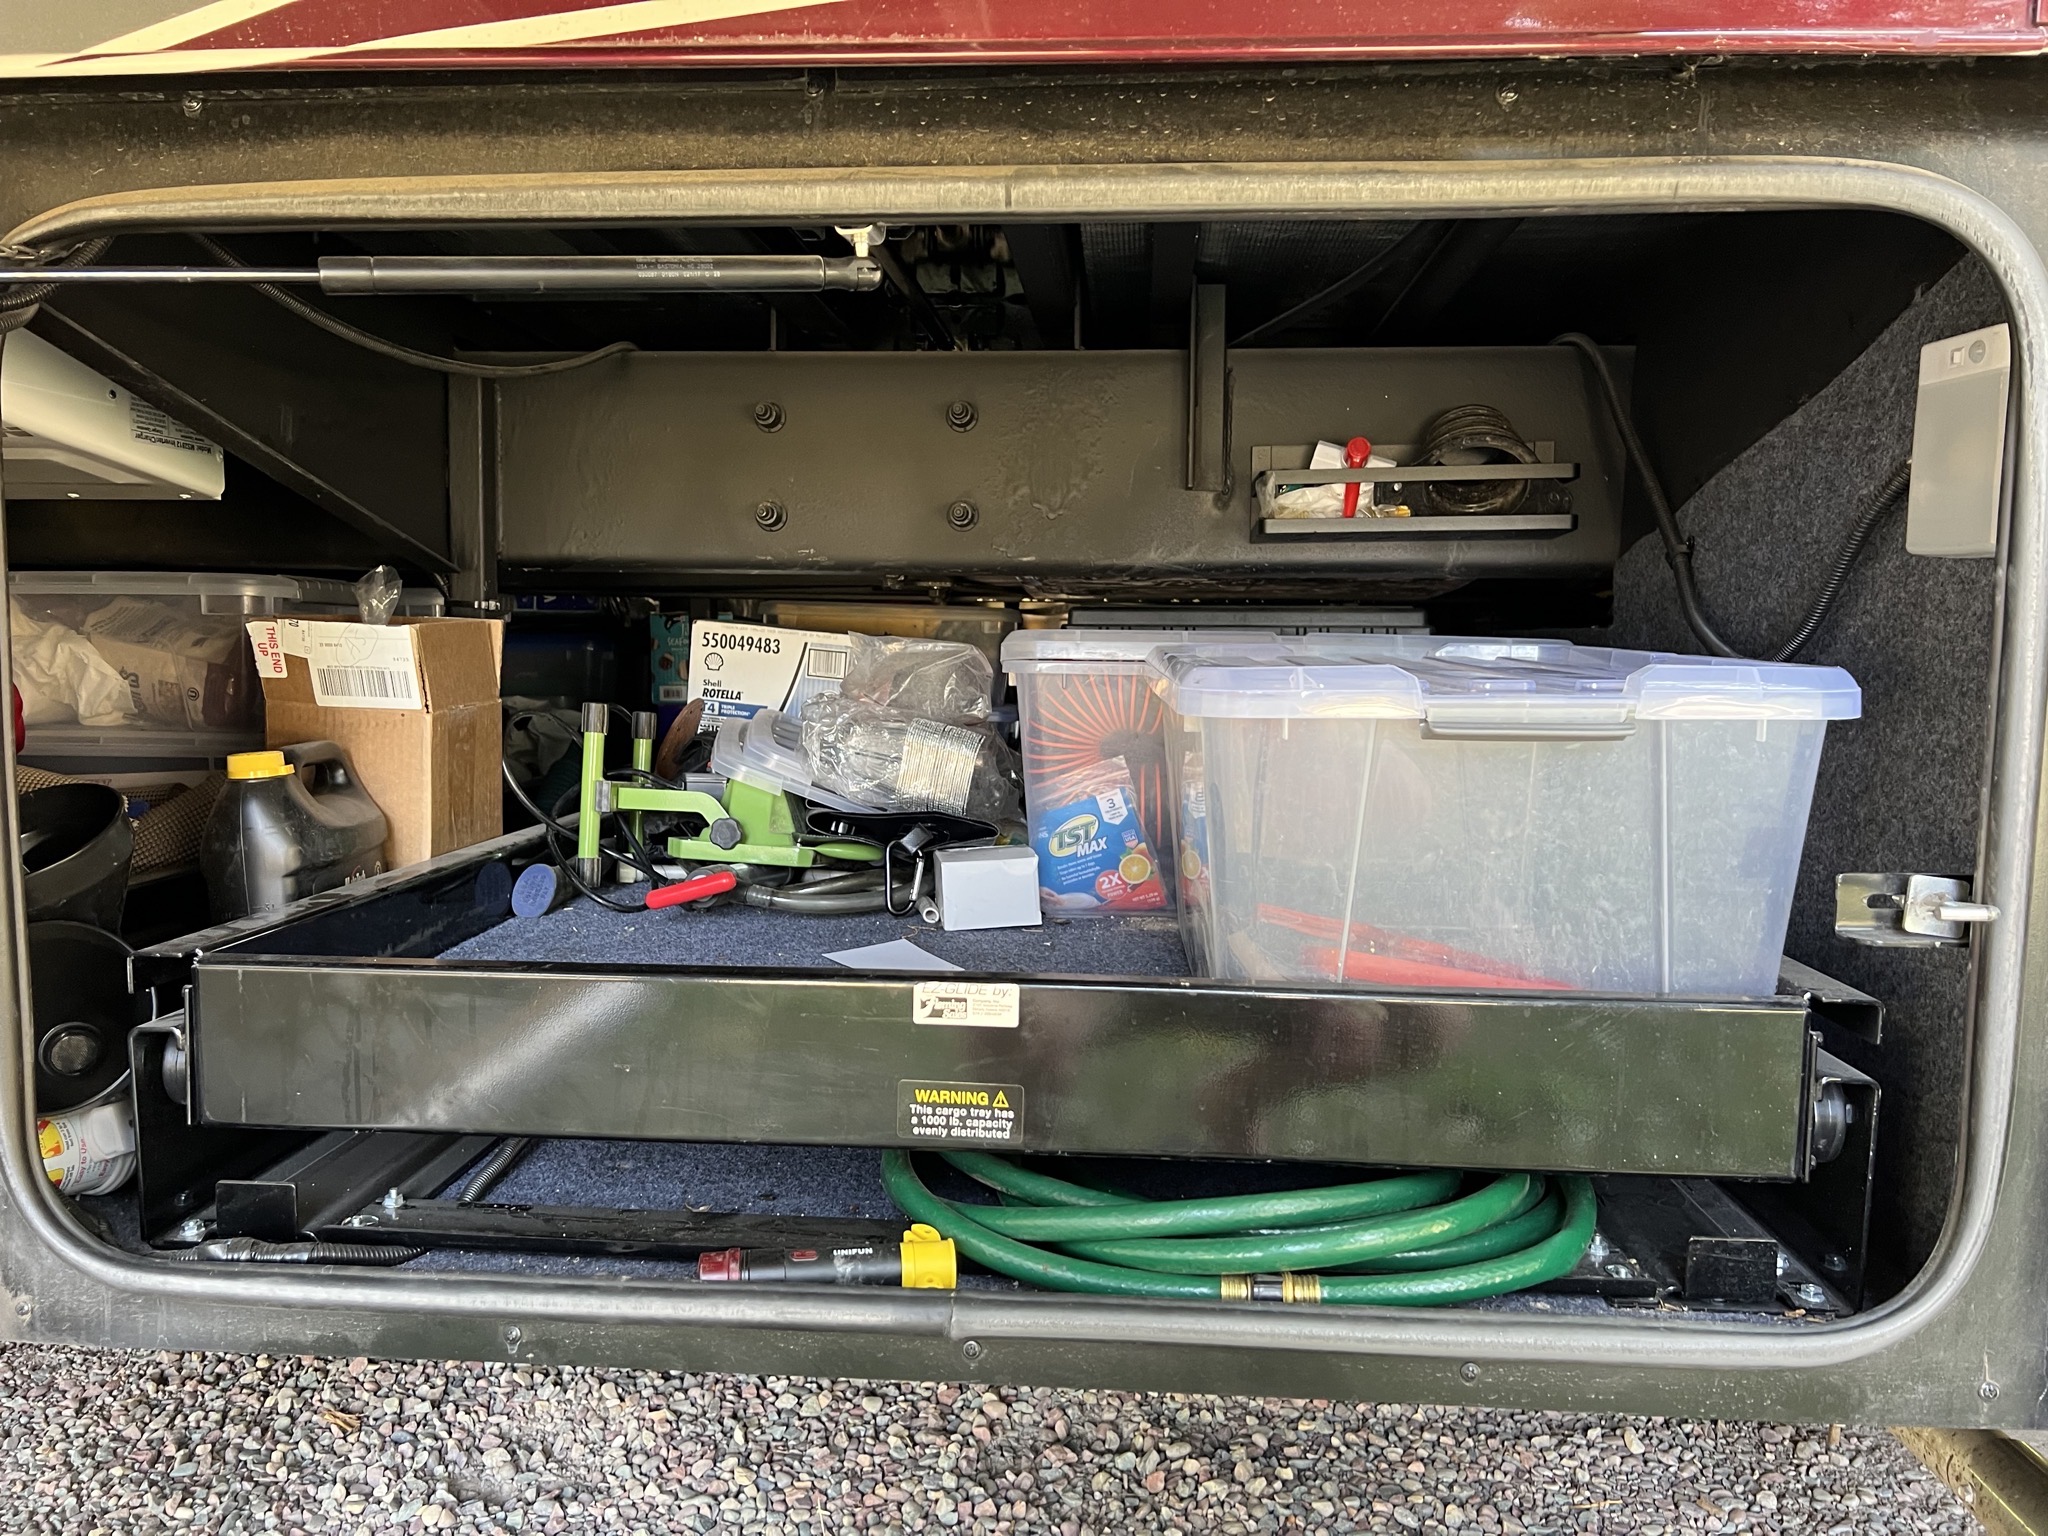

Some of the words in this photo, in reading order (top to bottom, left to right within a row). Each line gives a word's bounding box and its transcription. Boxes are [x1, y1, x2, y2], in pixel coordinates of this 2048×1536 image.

[265, 626, 279, 650] THIS
[701, 632, 781, 654] 550049483
[257, 642, 269, 657] UP
[271, 649, 283, 674] END
[702, 678, 722, 688] Shell
[702, 687, 742, 701] ROTELLA
[720, 703, 735, 711] TRIPLE
[1106, 798, 1116, 809] 3
[1052, 820, 1096, 851] TST
[1077, 836, 1108, 858] MAX
[1099, 872, 1123, 890] 2X
[922, 982, 987, 996] EZ-GLIDE
[993, 986, 1013, 998] by:
[914, 1088, 989, 1106] WARNING
[909, 1104, 933, 1115] This
[935, 1107, 967, 1118] cargo
[970, 1107, 992, 1119] tray
[994, 1108, 1015, 1119] has
[910, 1117, 918, 1125] a
[921, 1115, 947, 1126] 1000
[949, 1116, 963, 1127] lb.
[965, 1118, 1013, 1130] capacity
[912, 1126, 948, 1138] evenly
[950, 1127, 1011, 1139] distributed
[80, 1156, 87, 1165] to
[833, 1247, 874, 1256] UNIFUN
